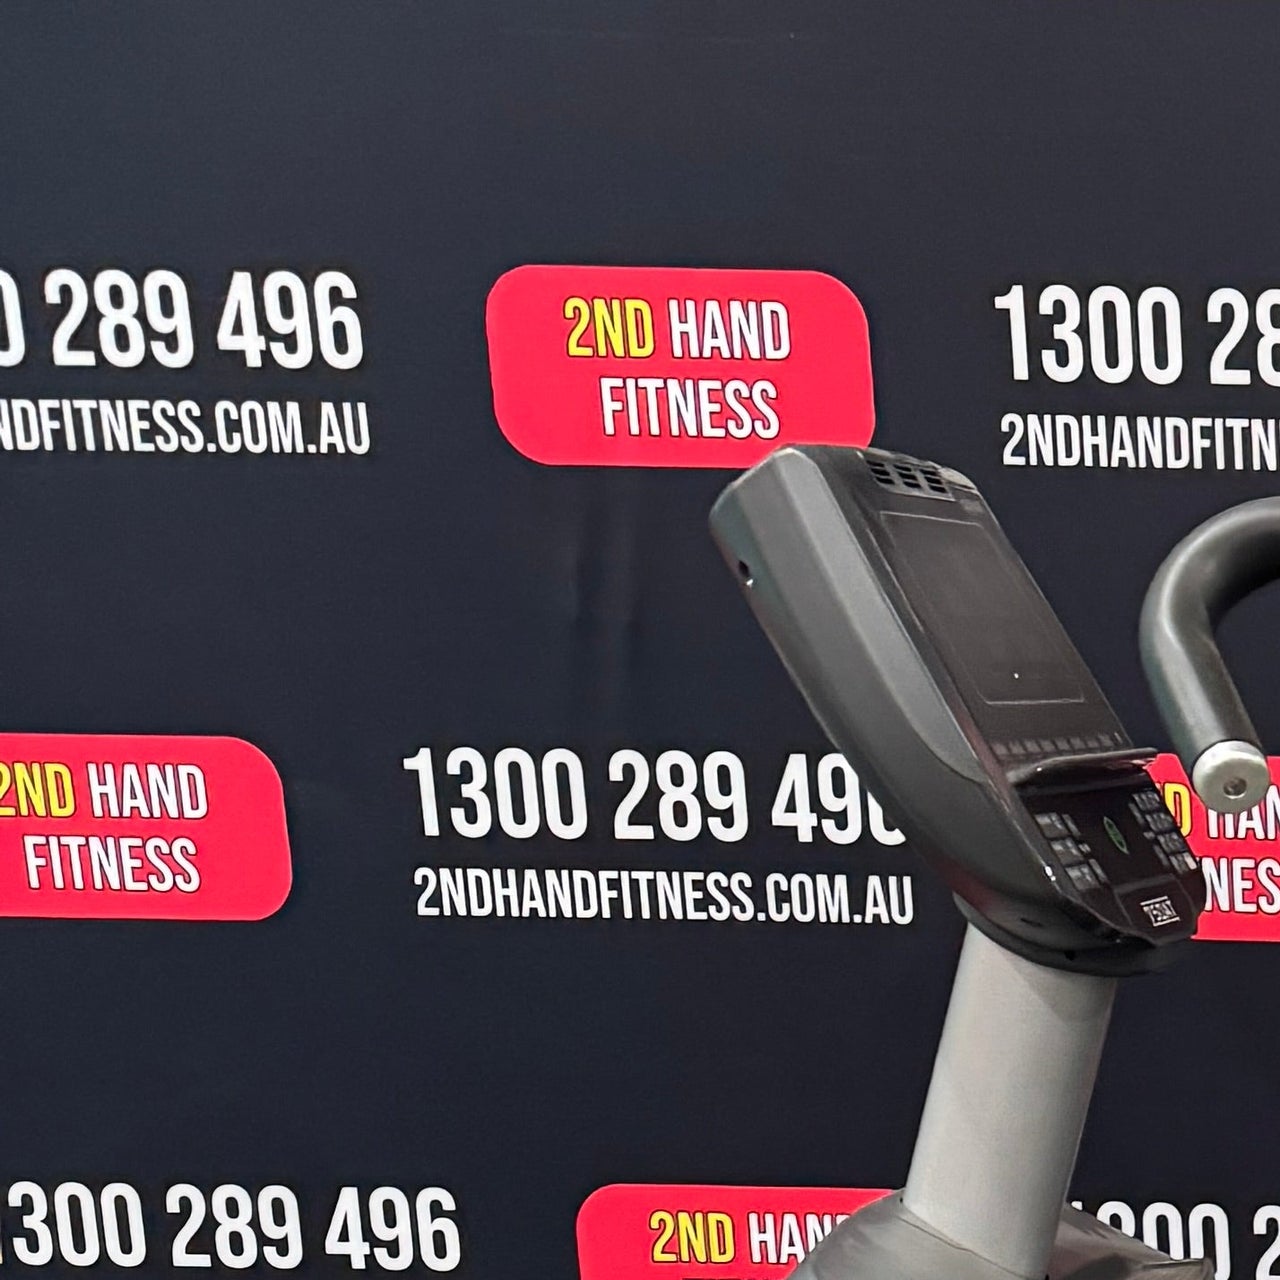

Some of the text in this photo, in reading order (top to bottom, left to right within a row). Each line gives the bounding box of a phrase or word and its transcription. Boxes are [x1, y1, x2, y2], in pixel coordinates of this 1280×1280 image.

[44, 268, 194, 369] 289
[216, 270, 364, 370] 496
[564, 297, 791, 360] 2ND HAND
[994, 284, 1183, 385] 1300
[600, 377, 780, 439] FITNESS
[87, 763, 208, 819] HAND
[403, 746, 588, 840] 1300
[608, 749, 749, 843] 289
[23, 835, 200, 892] FITNESS
[413, 866, 914, 925] 2NDHANDFITNESS.COM.AU
[0, 1180, 461, 1272] 300 289 496
[650, 1210, 851, 1266] 2ND HAN
